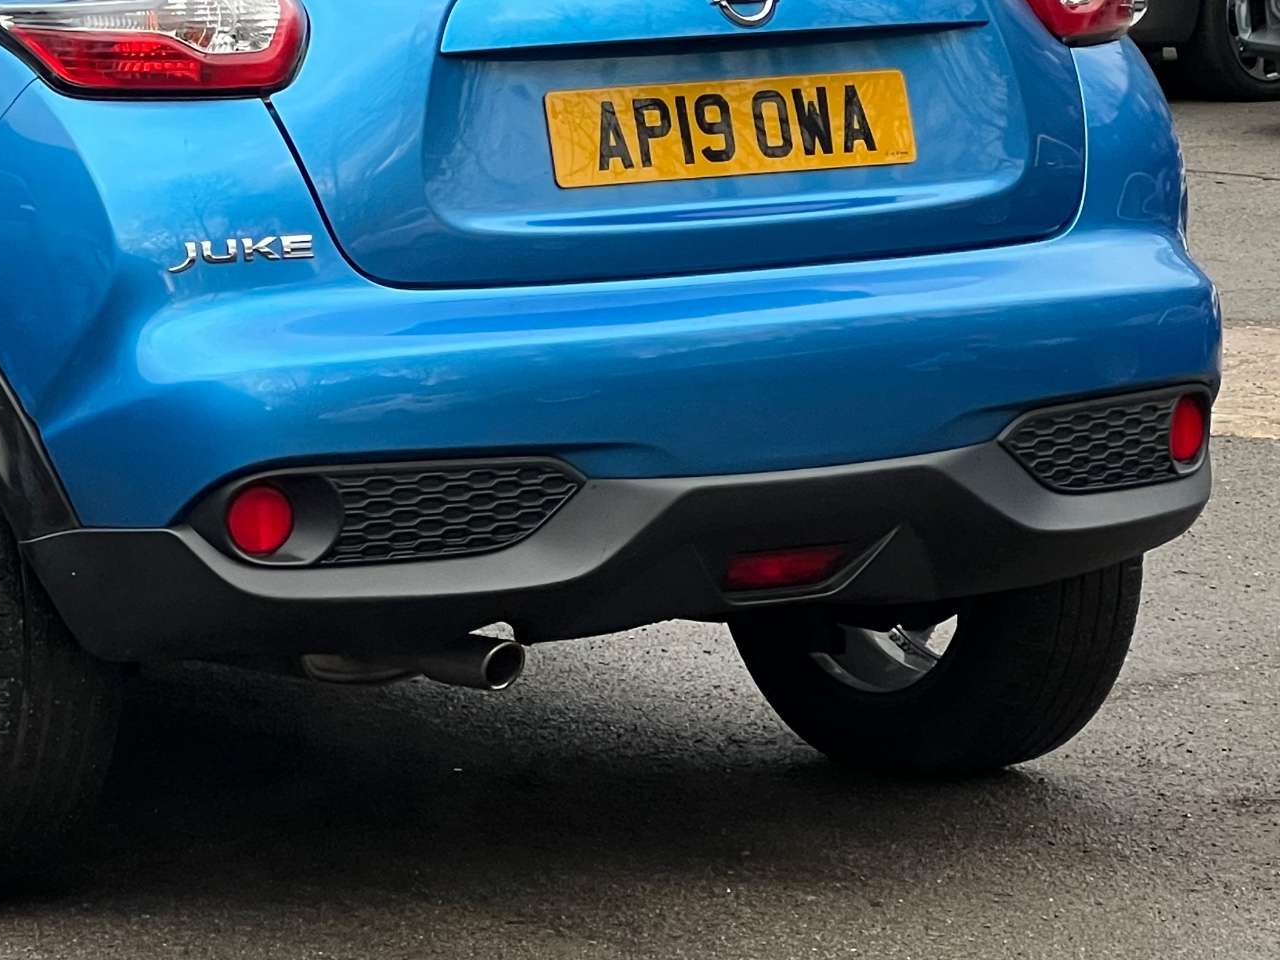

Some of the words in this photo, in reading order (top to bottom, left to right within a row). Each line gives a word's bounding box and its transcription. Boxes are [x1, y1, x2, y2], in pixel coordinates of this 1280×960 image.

[598, 93, 735, 171] AP19
[751, 84, 877, 159] OWA
[168, 234, 314, 273] JUKE
